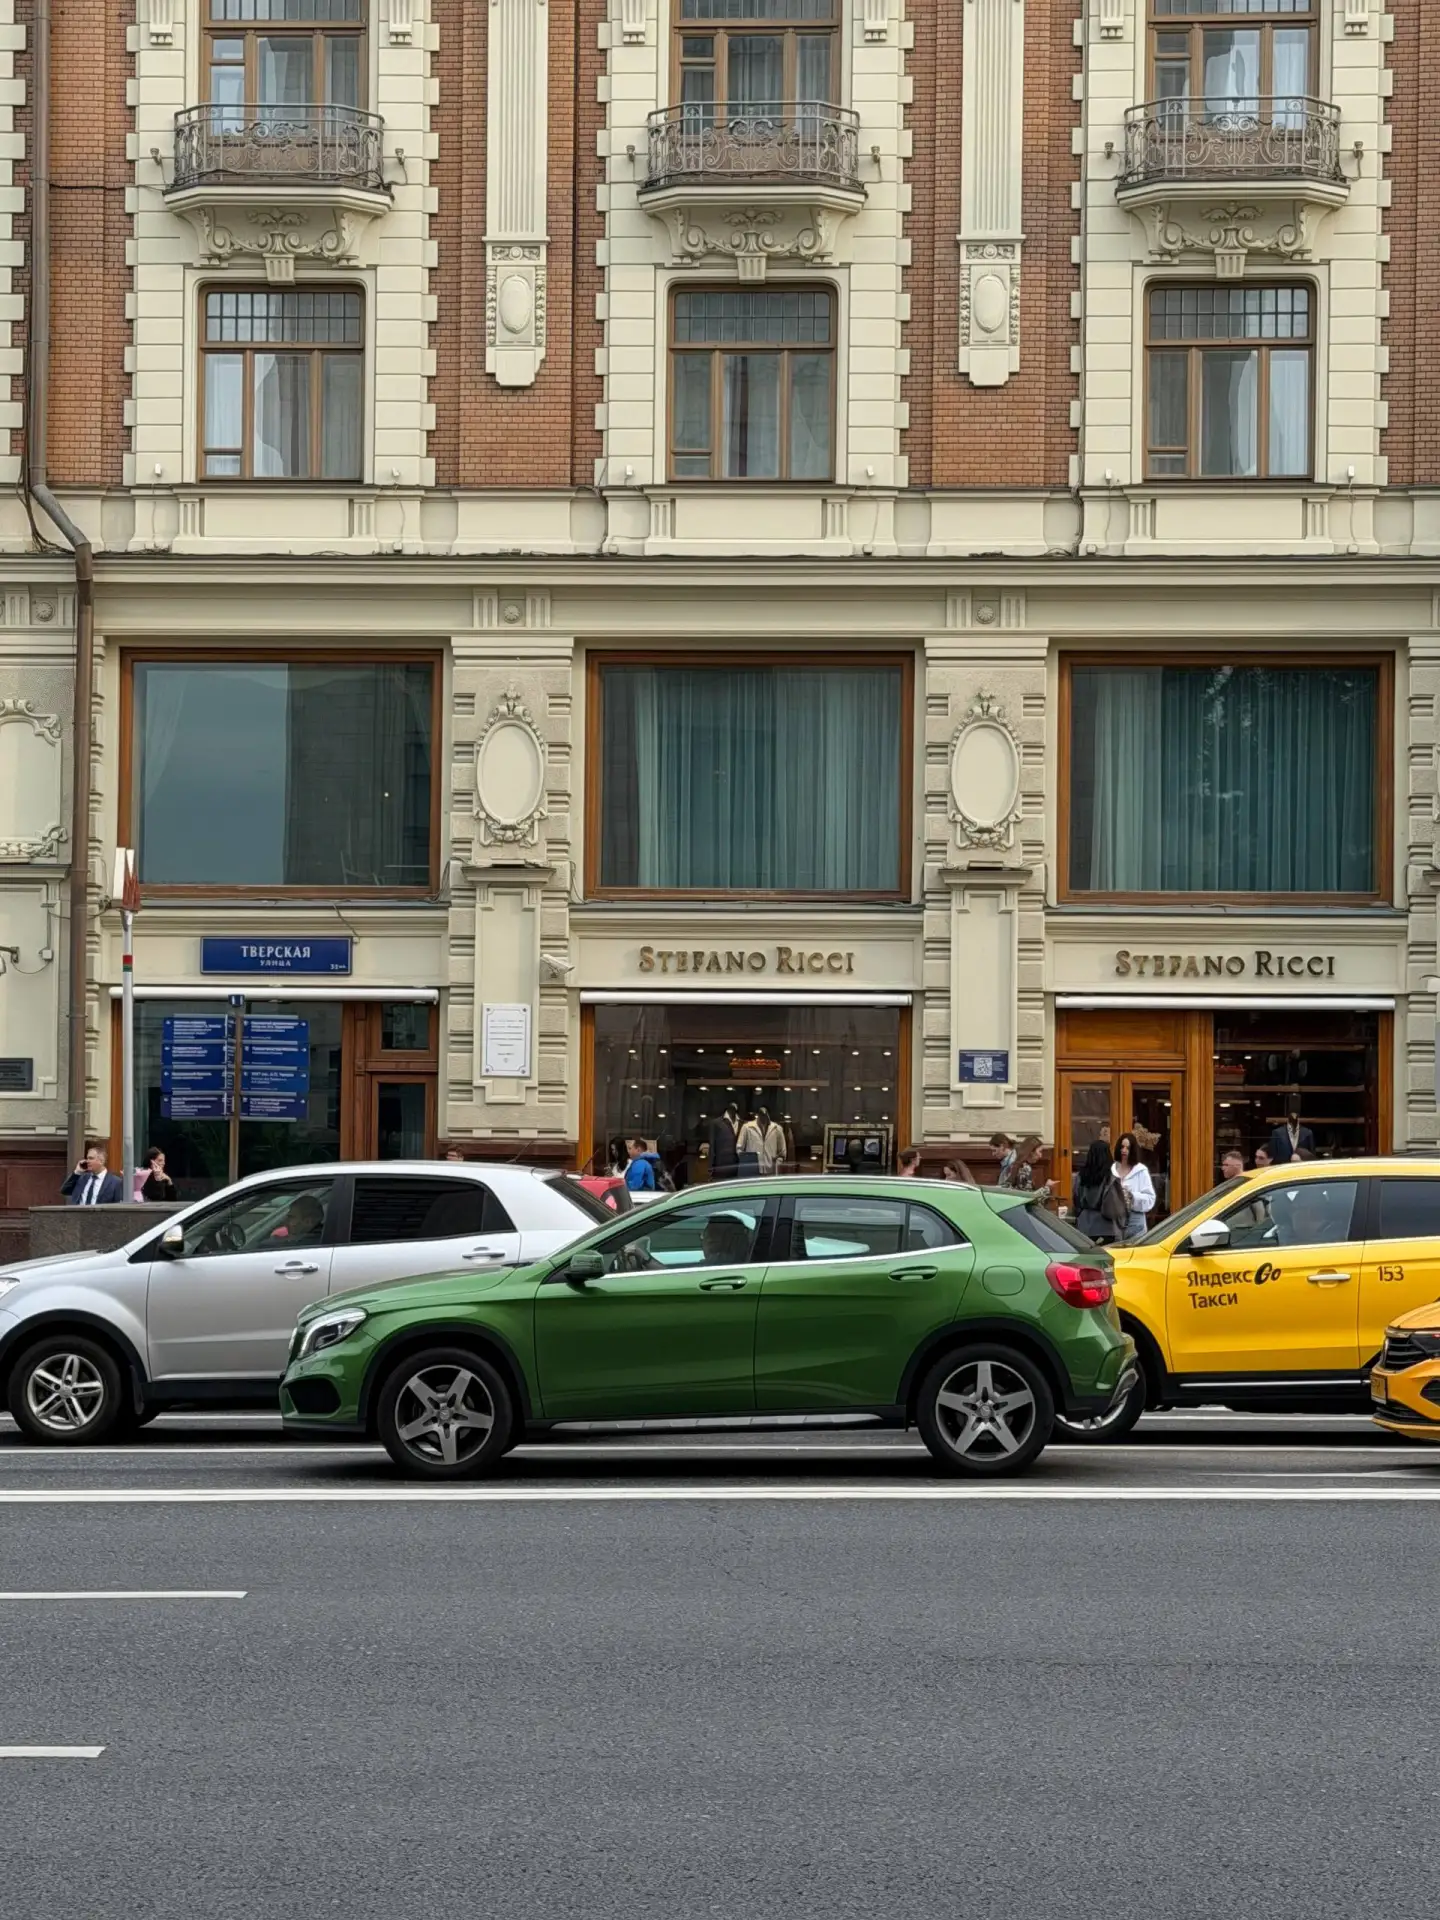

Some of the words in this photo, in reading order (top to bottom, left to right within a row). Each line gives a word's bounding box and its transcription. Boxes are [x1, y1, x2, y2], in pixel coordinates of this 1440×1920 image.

[240, 945, 311, 958] ТВЕРСКАЯ
[638, 946, 767, 973] STEFANO
[776, 946, 855, 973] RICCI
[1115, 949, 1245, 977] STEFANO
[1254, 950, 1335, 977] RICCI
[1187, 1270, 1253, 1288] Яндекс
[1254, 1262, 1282, 1285] Go
[1377, 1265, 1405, 1282] 153
[1188, 1292, 1239, 1310] Такси
